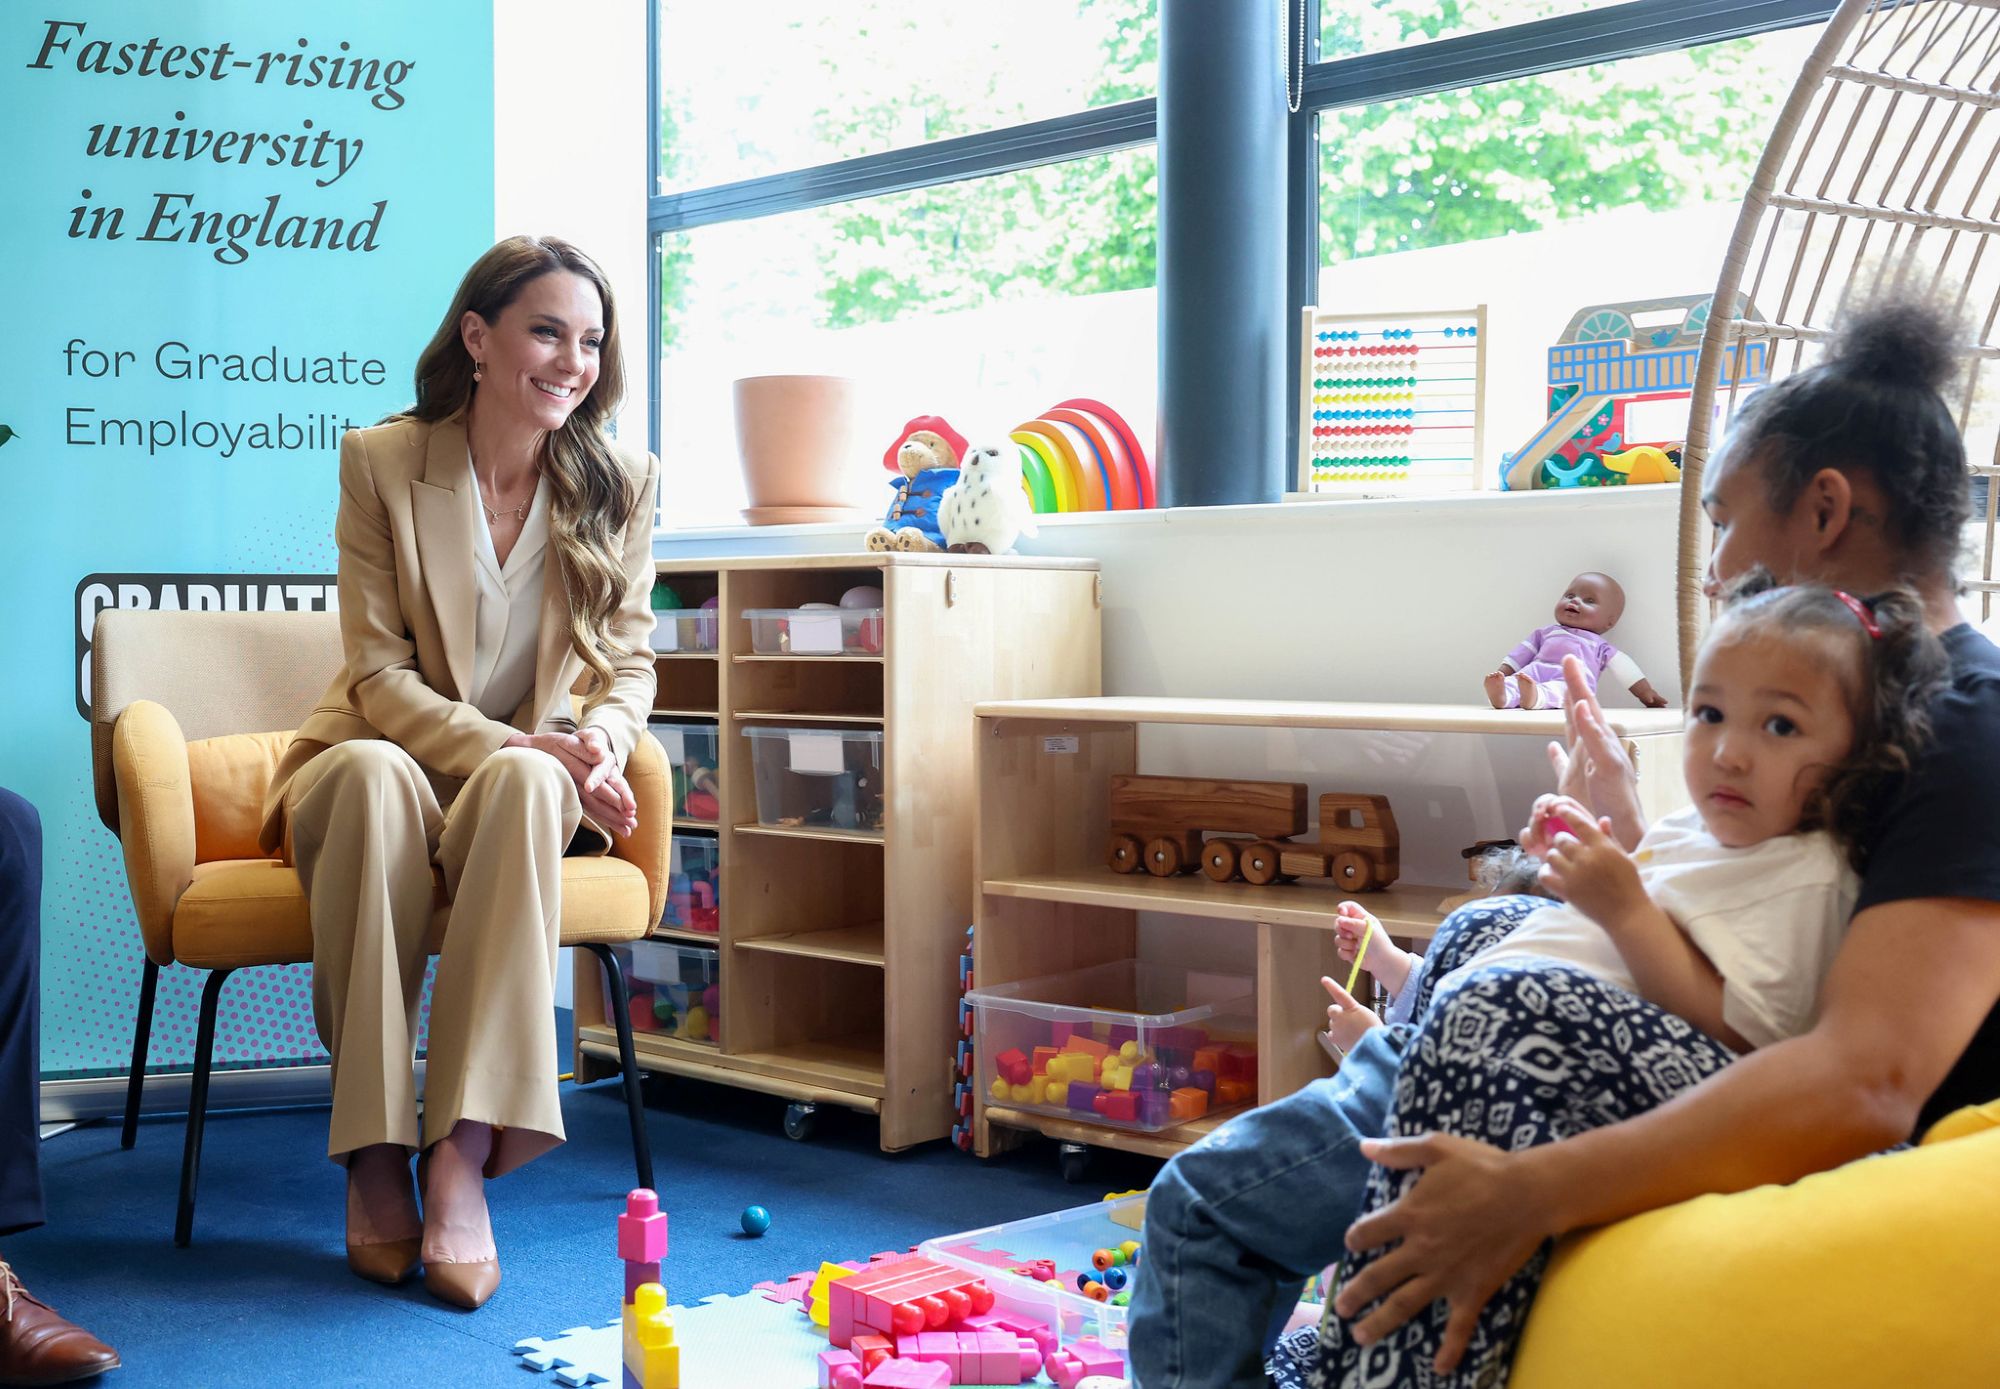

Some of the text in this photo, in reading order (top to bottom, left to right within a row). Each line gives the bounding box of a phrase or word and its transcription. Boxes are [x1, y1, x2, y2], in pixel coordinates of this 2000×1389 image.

[26, 19, 416, 111] Fastest-rising
[85, 110, 365, 188] university
[67, 188, 389, 265] in England
[62, 338, 387, 386] for Graduate
[66, 407, 368, 459] Employabilit
